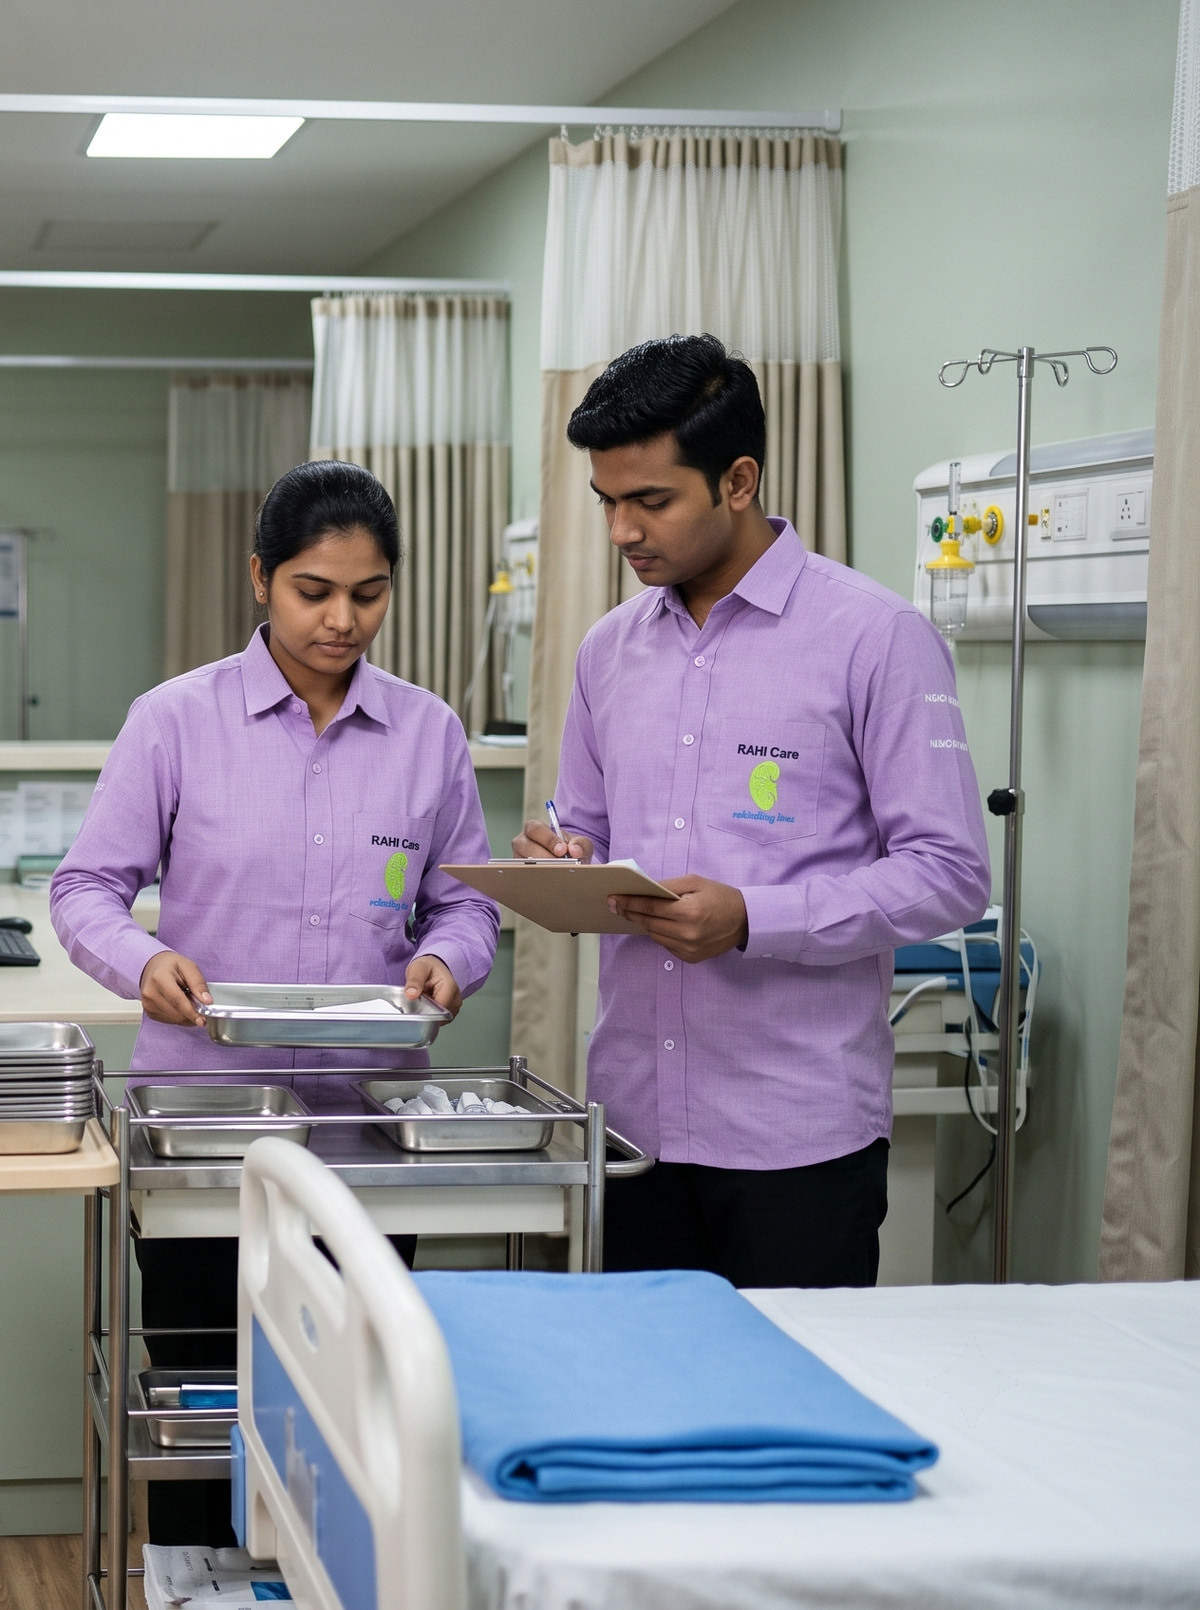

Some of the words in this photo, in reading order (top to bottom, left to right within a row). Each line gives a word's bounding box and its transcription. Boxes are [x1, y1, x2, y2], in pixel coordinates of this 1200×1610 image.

[737, 743, 768, 757] RAHI
[770, 746, 800, 760] Care
[371, 834, 400, 848] RAHI
